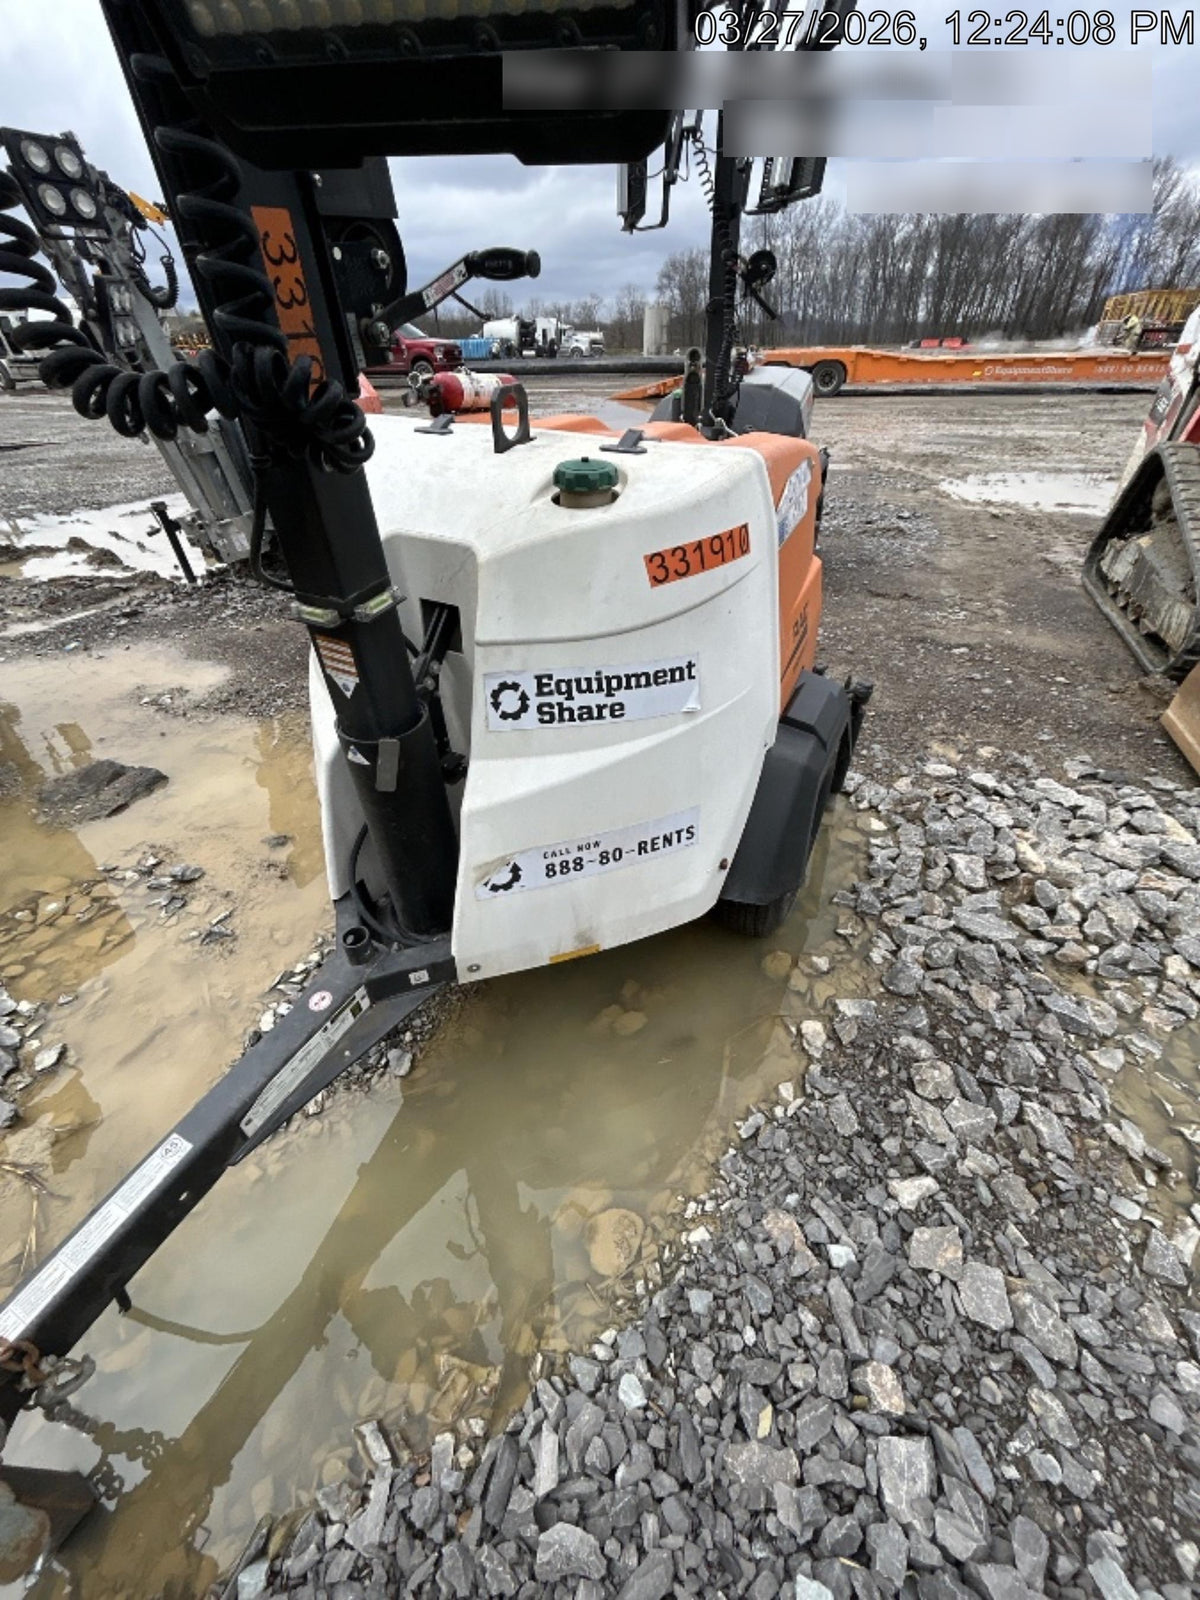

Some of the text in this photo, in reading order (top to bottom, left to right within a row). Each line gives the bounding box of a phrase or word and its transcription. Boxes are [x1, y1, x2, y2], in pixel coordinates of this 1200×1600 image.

[648, 523, 750, 584] 331910
[533, 659, 696, 701] Equipment
[535, 701, 626, 724] Share
[542, 839, 602, 860] CALL NOW
